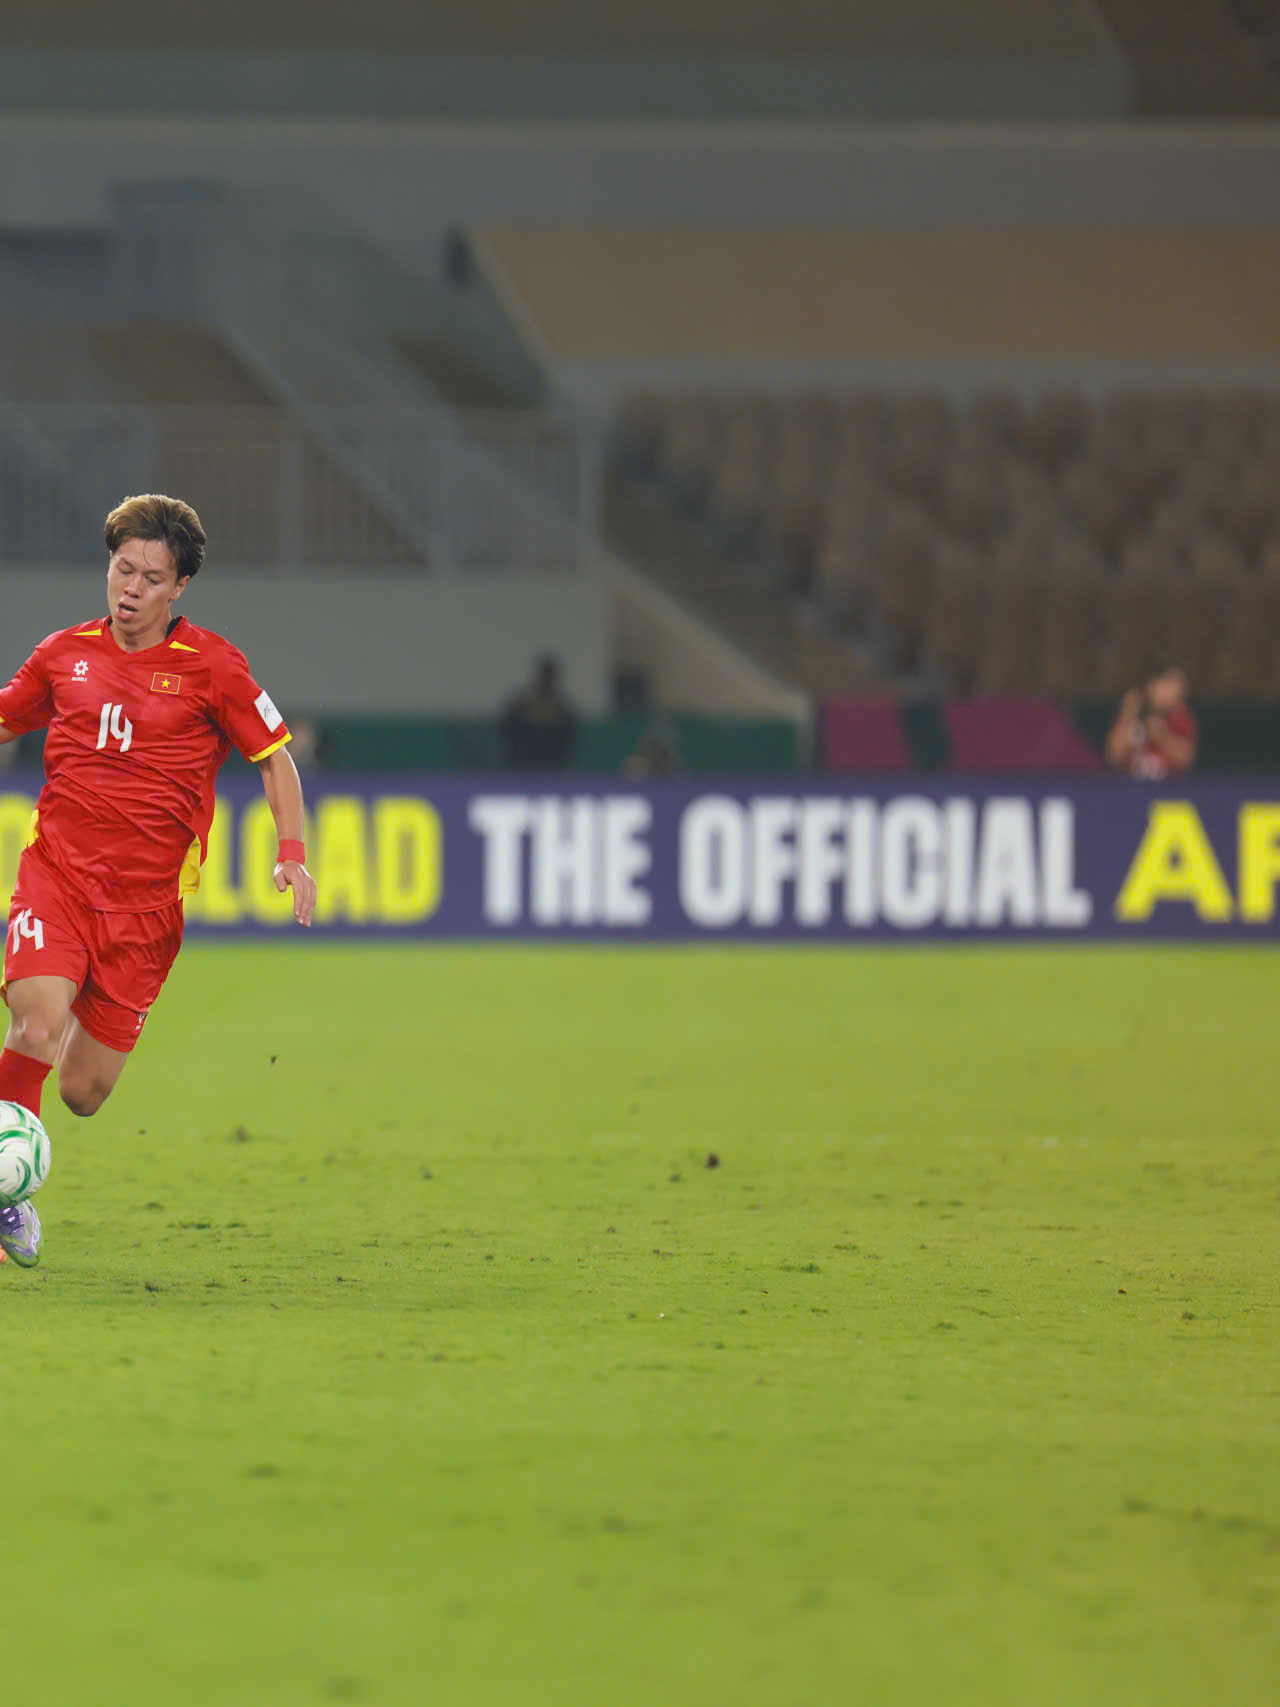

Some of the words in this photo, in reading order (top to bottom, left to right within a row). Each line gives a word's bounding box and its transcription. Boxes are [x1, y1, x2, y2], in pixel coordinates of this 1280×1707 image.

[96, 702, 133, 752] 14
[469, 795, 652, 926] THE
[677, 795, 1093, 927] OFFICIAL
[12, 908, 45, 955] 14
